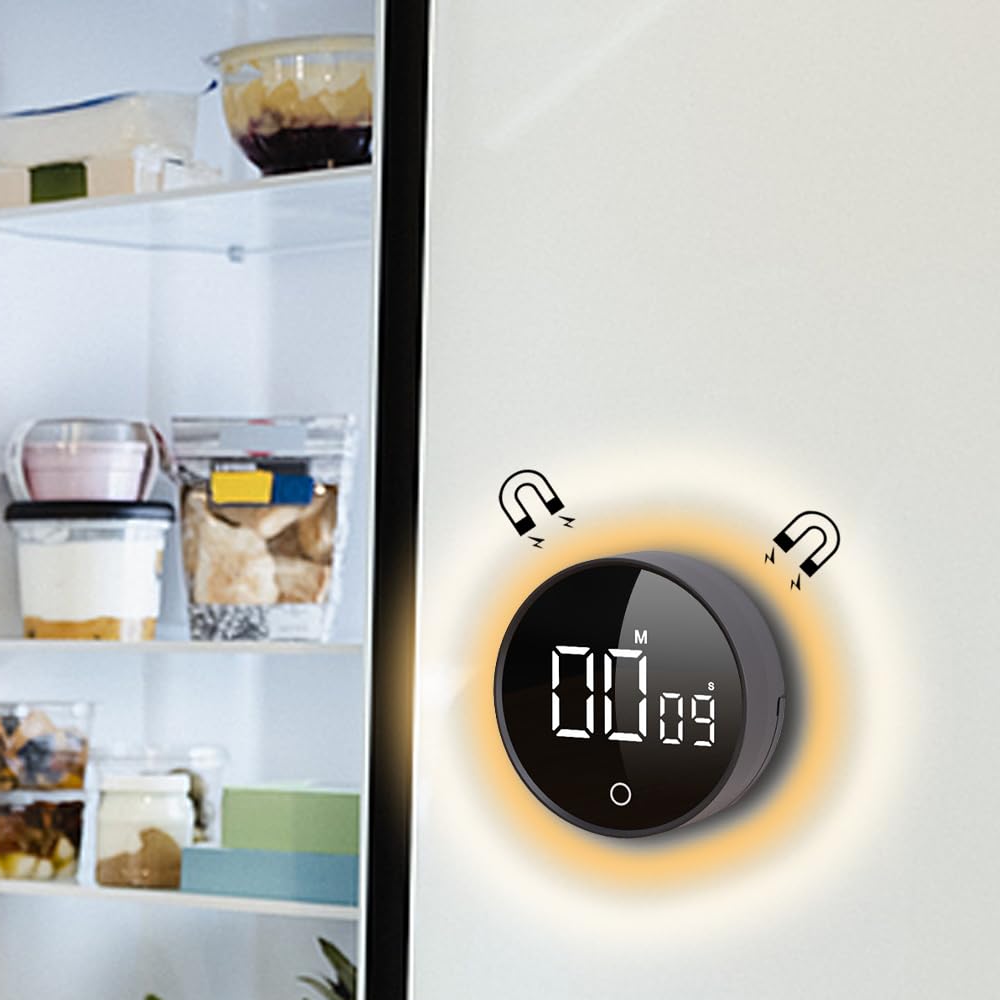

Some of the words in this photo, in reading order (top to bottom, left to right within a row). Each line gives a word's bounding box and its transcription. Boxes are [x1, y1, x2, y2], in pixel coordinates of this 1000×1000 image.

[634, 629, 648, 645] M
[551, 645, 647, 743] 00
[659, 692, 715, 747] 09
